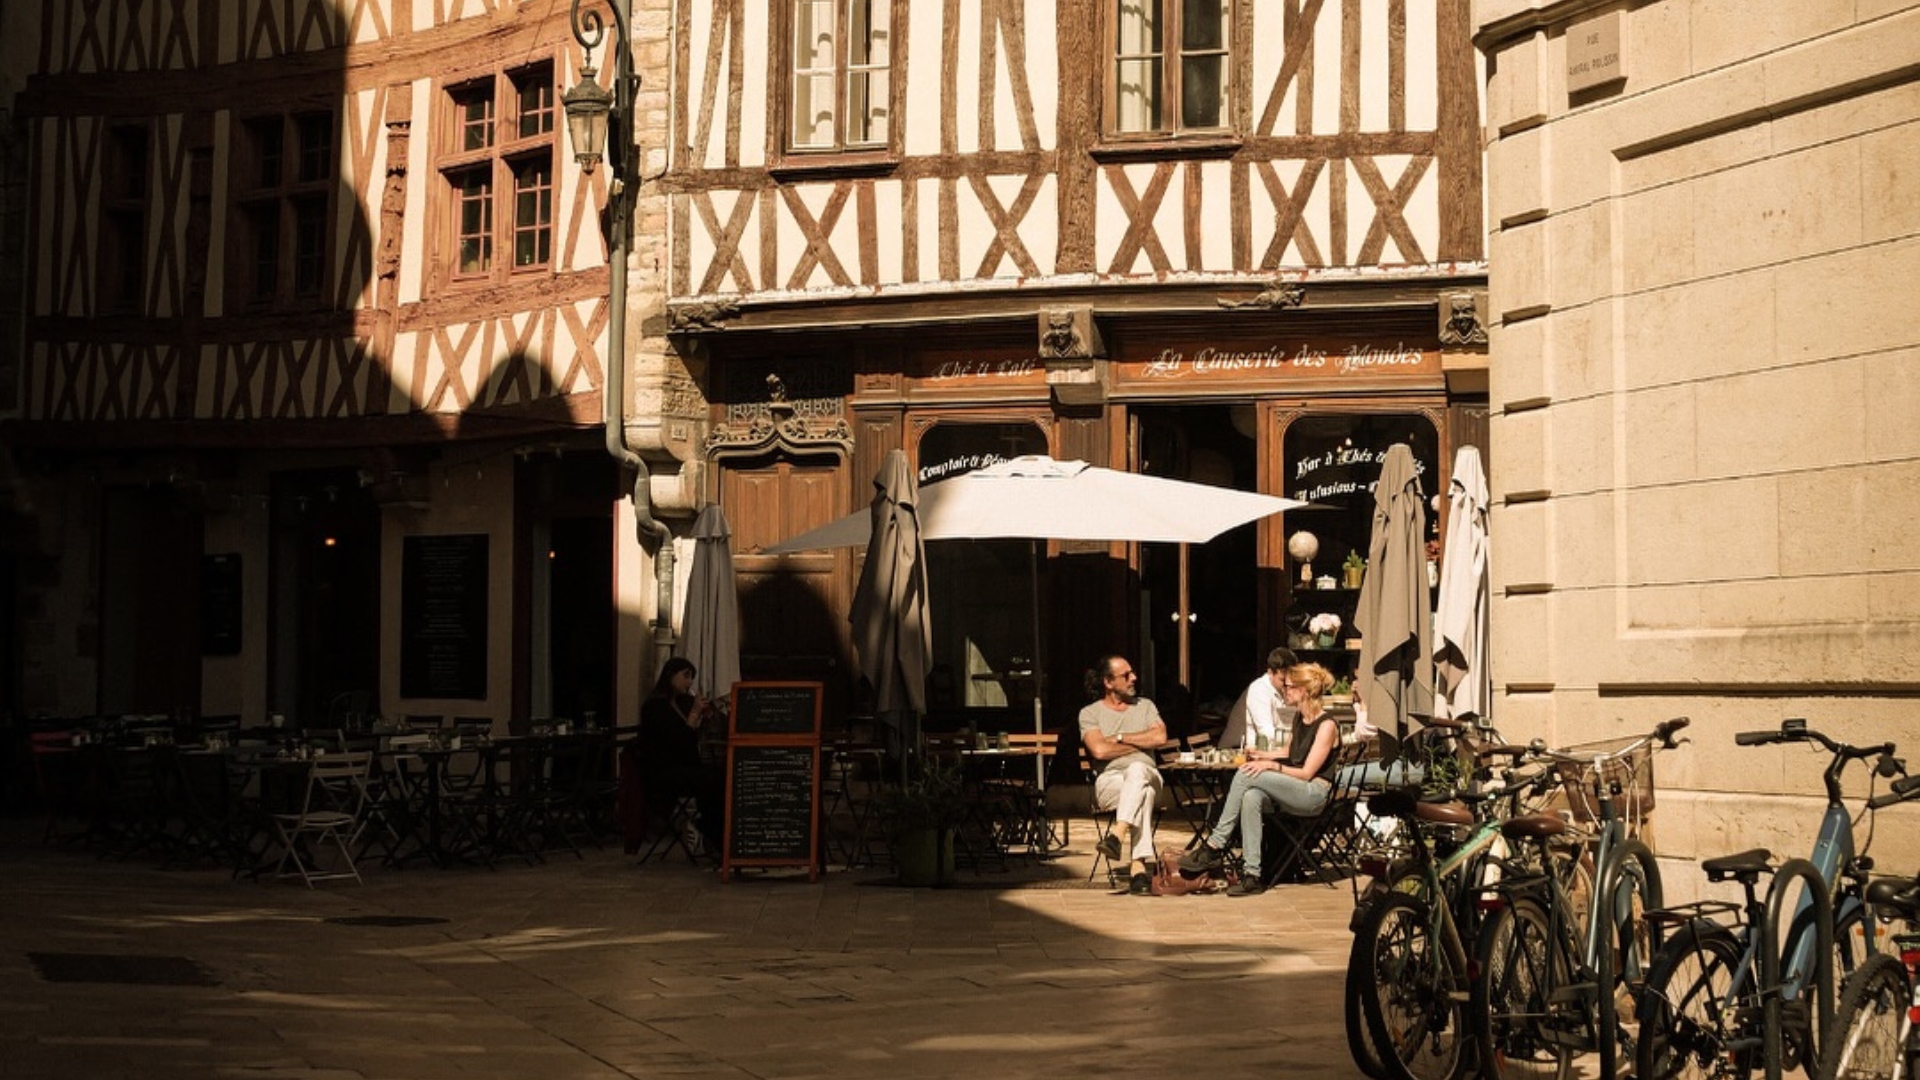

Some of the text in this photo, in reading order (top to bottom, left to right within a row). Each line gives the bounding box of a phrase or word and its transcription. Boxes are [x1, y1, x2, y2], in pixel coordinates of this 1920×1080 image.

[1141, 341, 1423, 378] La Causerie des Mondes
[919, 455, 969, 481] Comptoir
[1296, 456, 1321, 480] Bar
[1337, 447, 1372, 466] Thés
